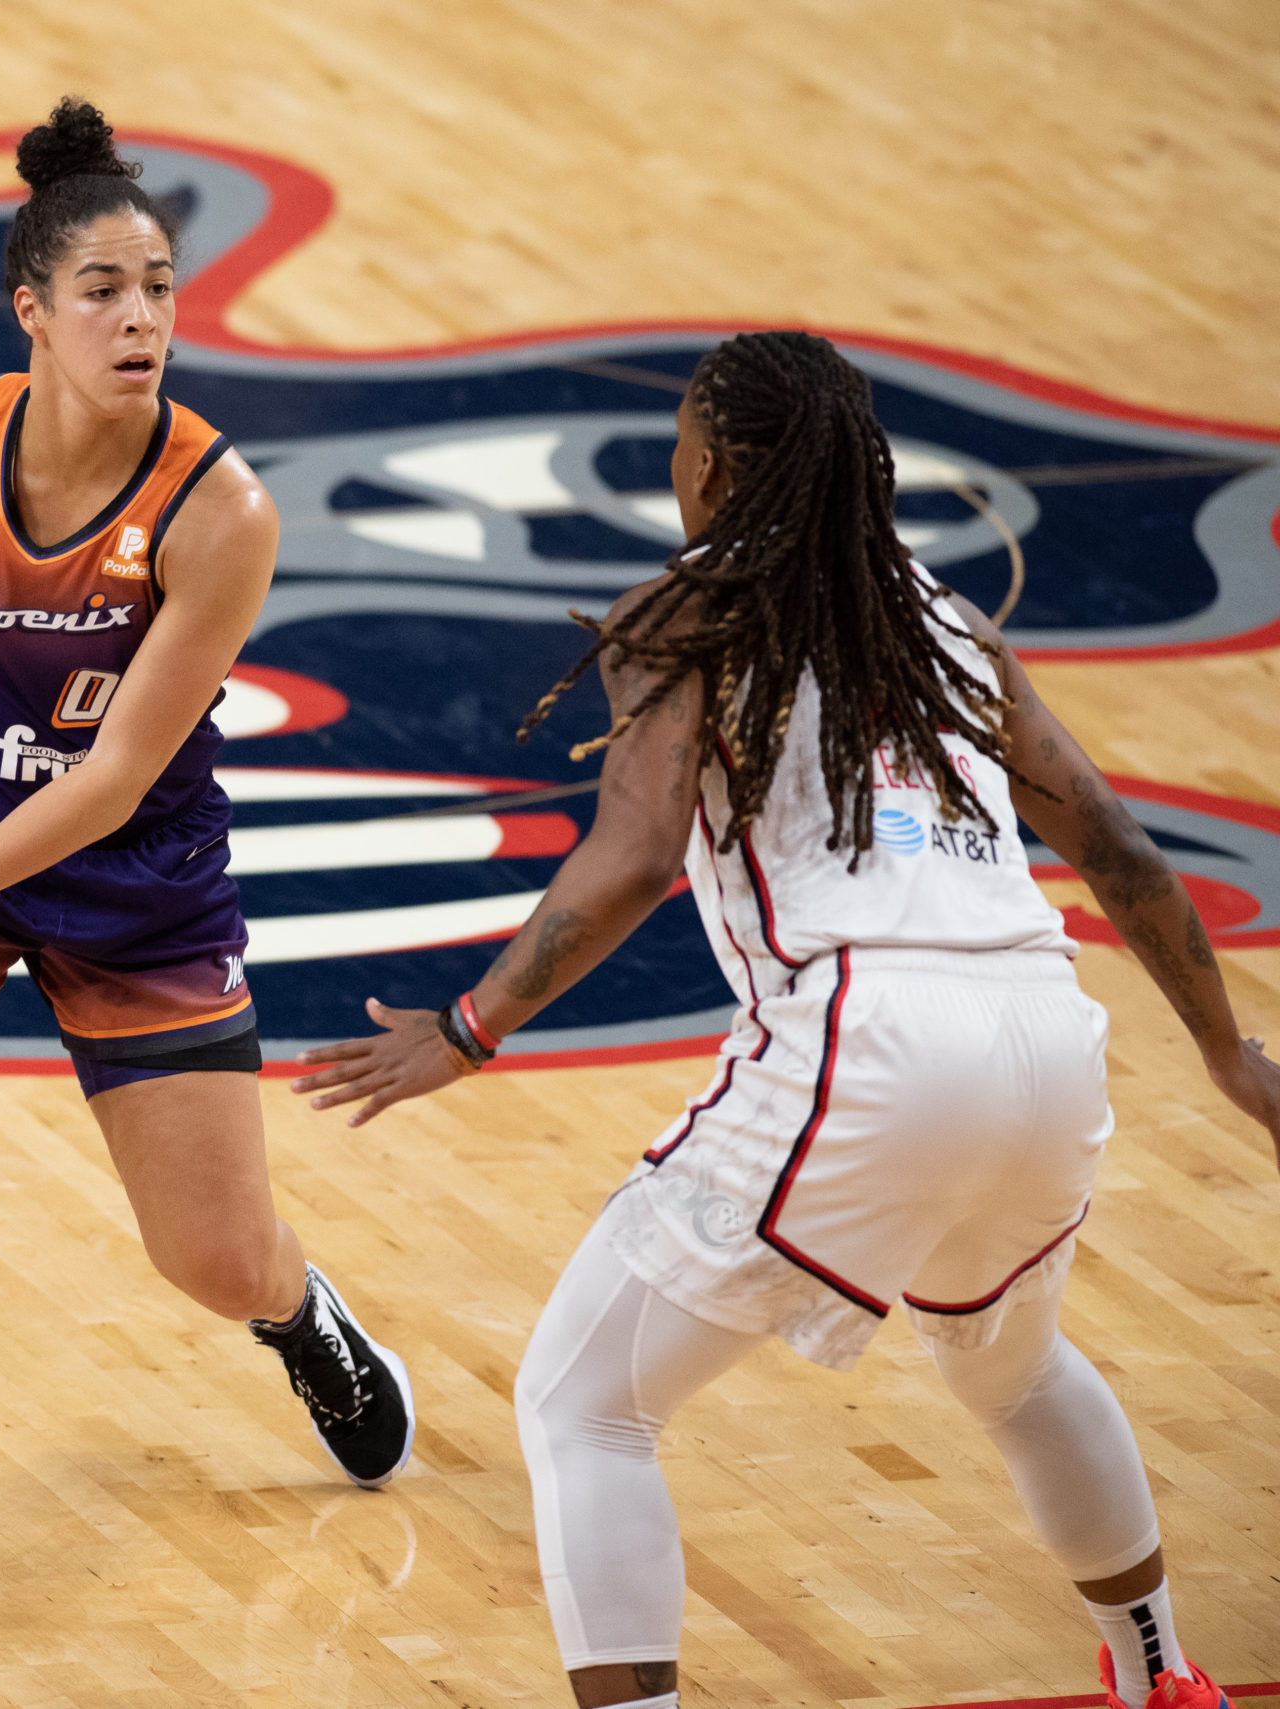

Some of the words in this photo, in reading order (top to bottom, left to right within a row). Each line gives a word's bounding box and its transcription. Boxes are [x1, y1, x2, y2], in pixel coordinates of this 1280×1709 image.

[51, 668, 120, 729] 0
[21, 746, 58, 758] FOOD
[62, 750, 87, 762] STO
[931, 822, 1000, 865] AT&T
